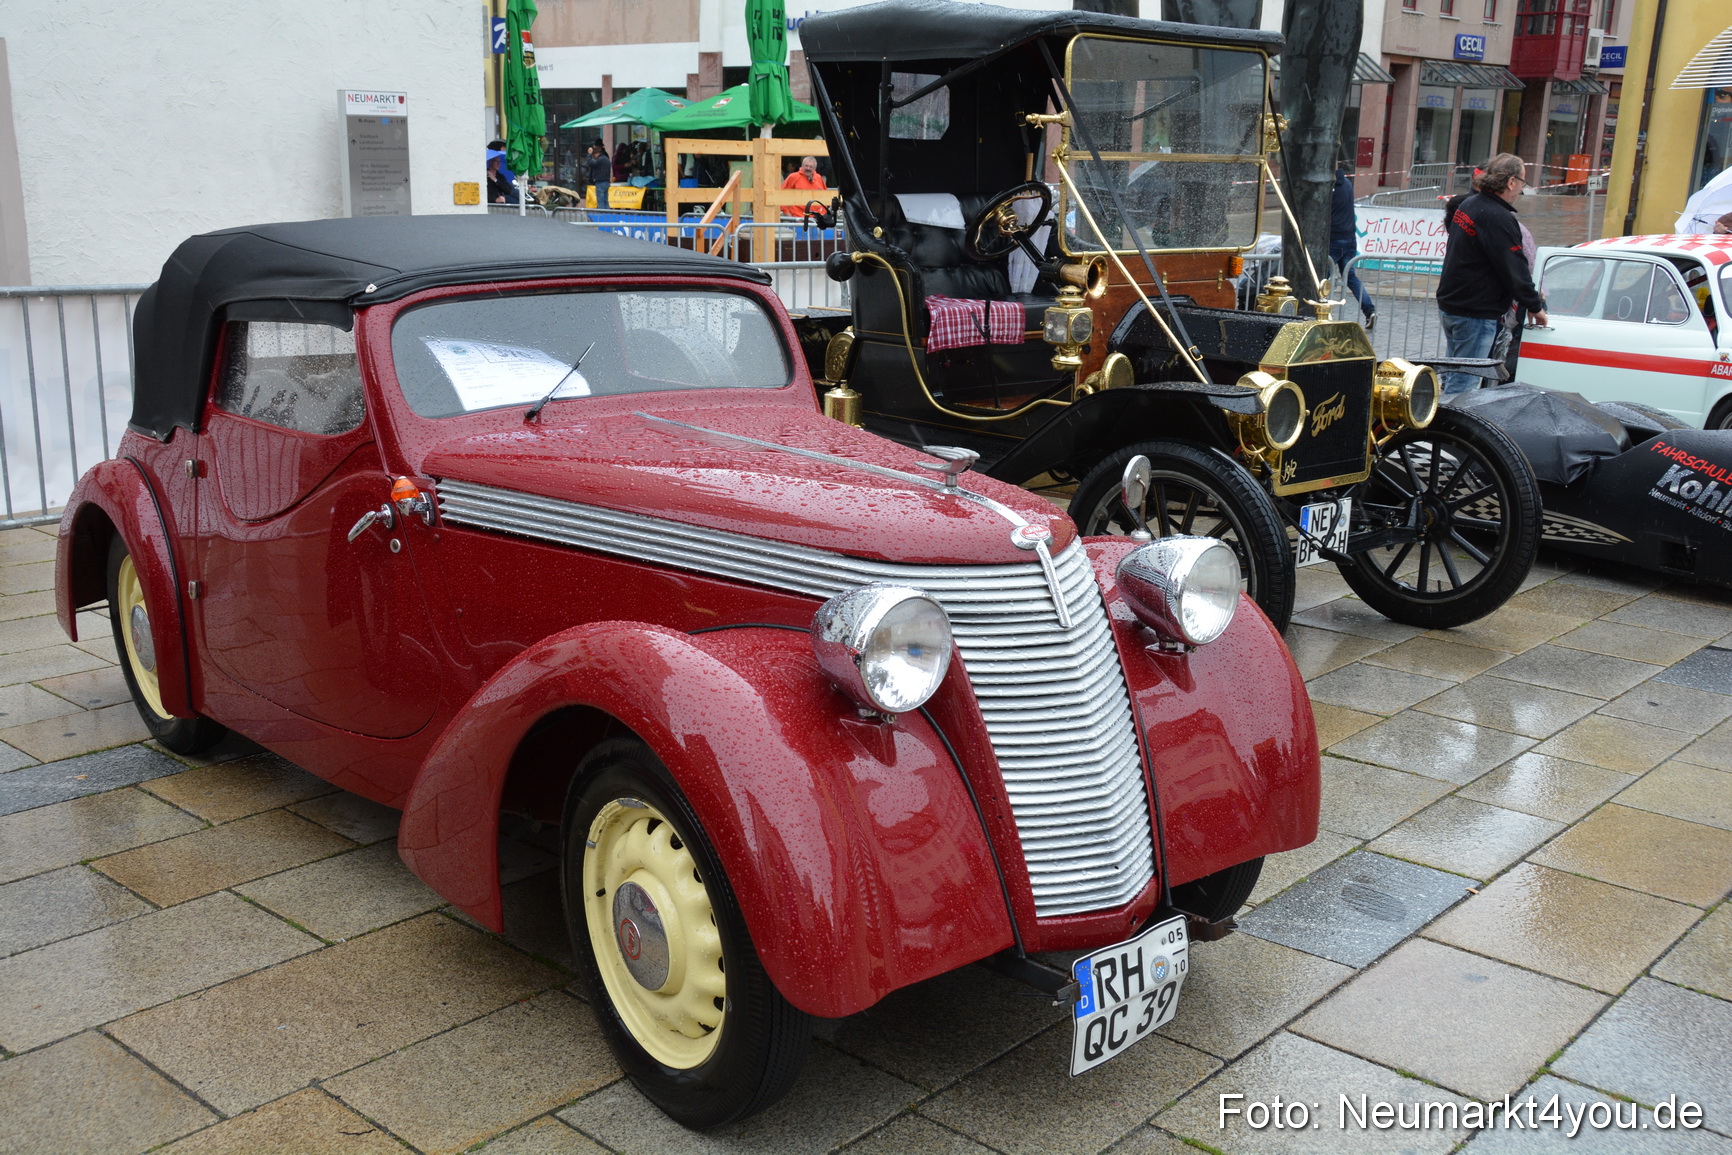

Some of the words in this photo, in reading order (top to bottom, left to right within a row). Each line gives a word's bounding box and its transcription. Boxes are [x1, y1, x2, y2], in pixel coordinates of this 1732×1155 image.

[1460, 36, 1484, 52] CECIL
[348, 94, 396, 103] NEUMARKT
[1426, 95, 1446, 107] CECIL
[1469, 97, 1487, 109] CECIL
[613, 189, 638, 198] Express
[1392, 220, 1425, 236] UNS
[1428, 219, 1449, 237] LÄ
[1311, 391, 1346, 438] Ford
[1650, 441, 1732, 485] FAHRSCHULE
[1648, 487, 1687, 511] Neumarkt
[1687, 506, 1721, 524] Altdorf
[1168, 927, 1183, 944] 05
[1174, 959, 1186, 975] 10
[1094, 946, 1145, 1009] RH
[1081, 995, 1089, 1010] D
[1084, 1004, 1129, 1062] QC
[1136, 980, 1177, 1035] 39
